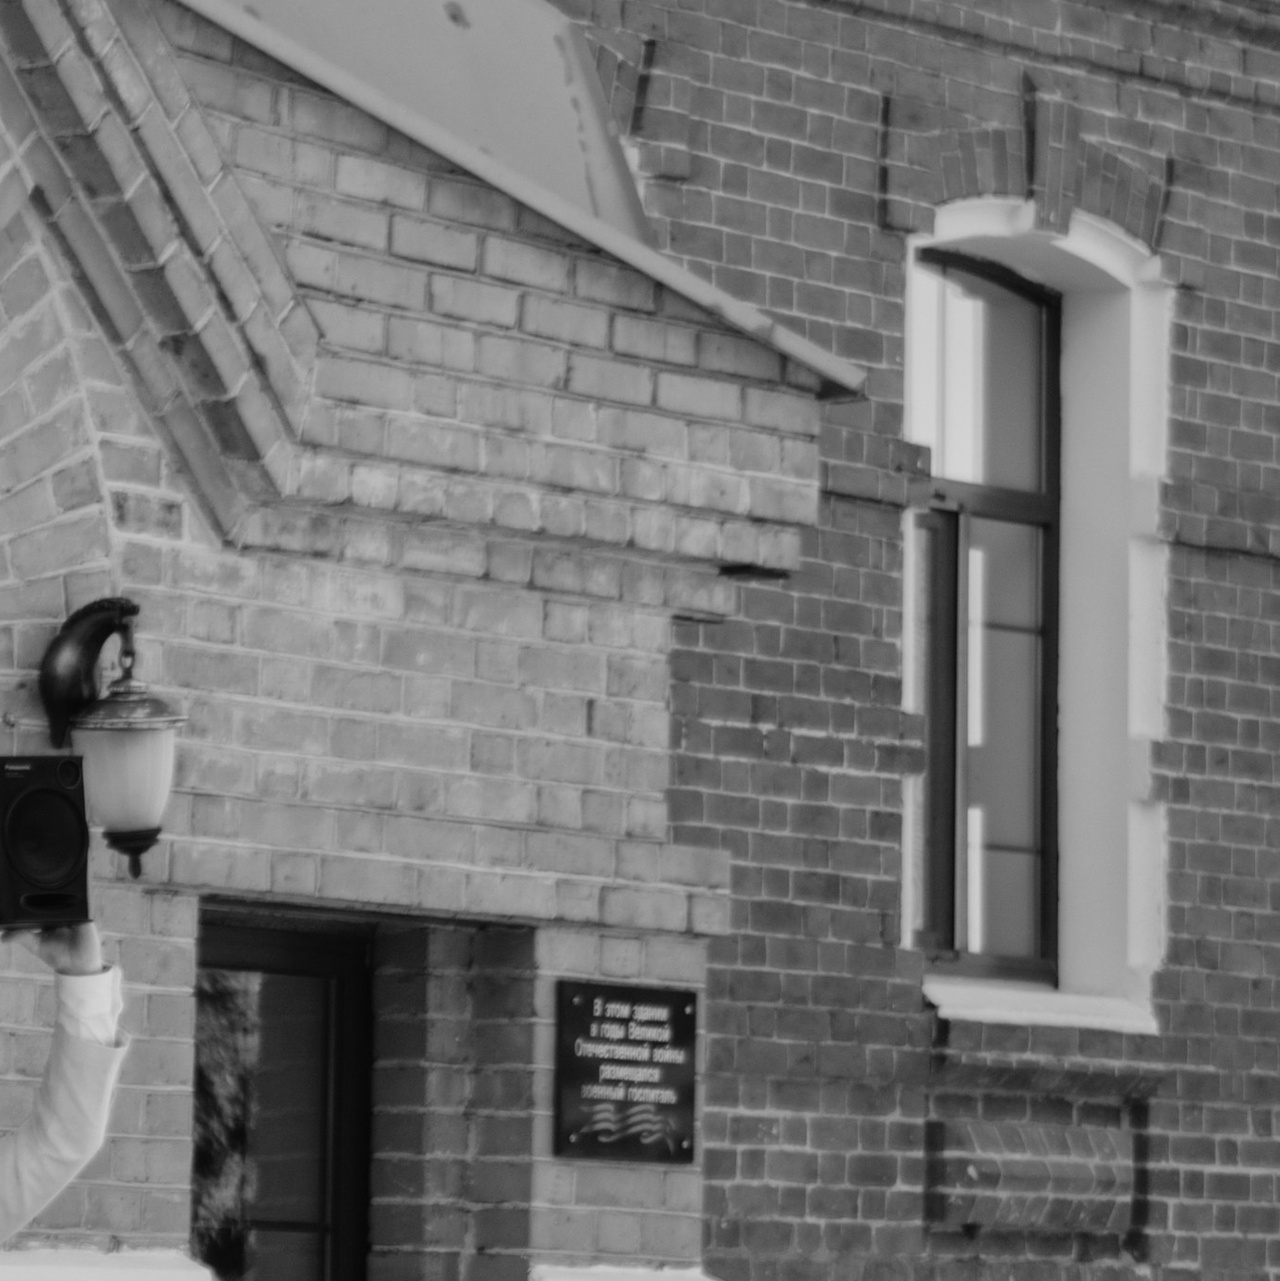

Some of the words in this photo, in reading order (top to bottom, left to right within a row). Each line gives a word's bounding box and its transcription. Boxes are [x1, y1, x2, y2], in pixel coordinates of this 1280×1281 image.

[593, 998, 603, 1017] В
[605, 1003, 631, 1018] этом
[632, 1006, 669, 1022] здании
[590, 1023, 598, 1037] в
[600, 1022, 626, 1041] годы
[627, 1021, 671, 1043] Великой
[574, 1037, 651, 1062] Отечественной
[652, 1044, 686, 1064] войны
[598, 1064, 661, 1084] размещался
[581, 1082, 626, 1101] военный
[627, 1086, 678, 1105] госпиталь
